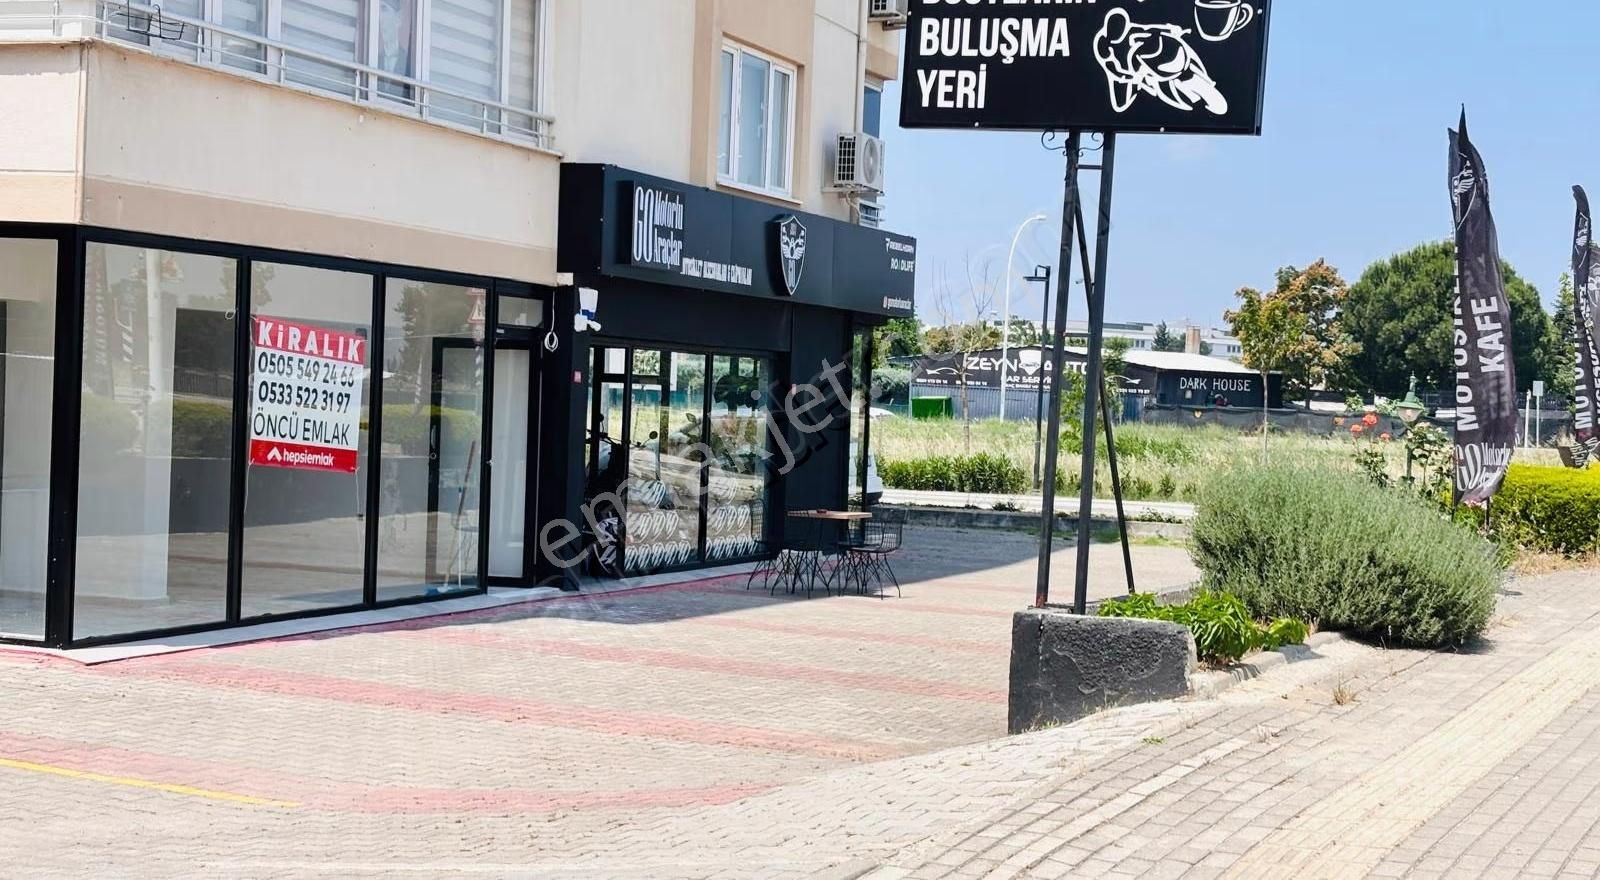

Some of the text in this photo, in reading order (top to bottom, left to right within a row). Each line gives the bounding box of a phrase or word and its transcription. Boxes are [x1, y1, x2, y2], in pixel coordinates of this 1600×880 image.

[919, 17, 1070, 64] BULUŞMA
[917, 63, 987, 109] YERİ
[633, 186, 654, 263] GO
[654, 190, 683, 230] Motorlu
[1470, 296, 1505, 373] KAFE
[258, 351, 293, 378] 0505
[297, 359, 320, 382] 549
[322, 362, 337, 385] 24
[1180, 377, 1251, 392] DARK HOUSE
[258, 380, 351, 414] 0533 522 31 97
[253, 406, 350, 446] ÖNCÜ EMLAK
[283, 448, 334, 467] hepsiemlak
